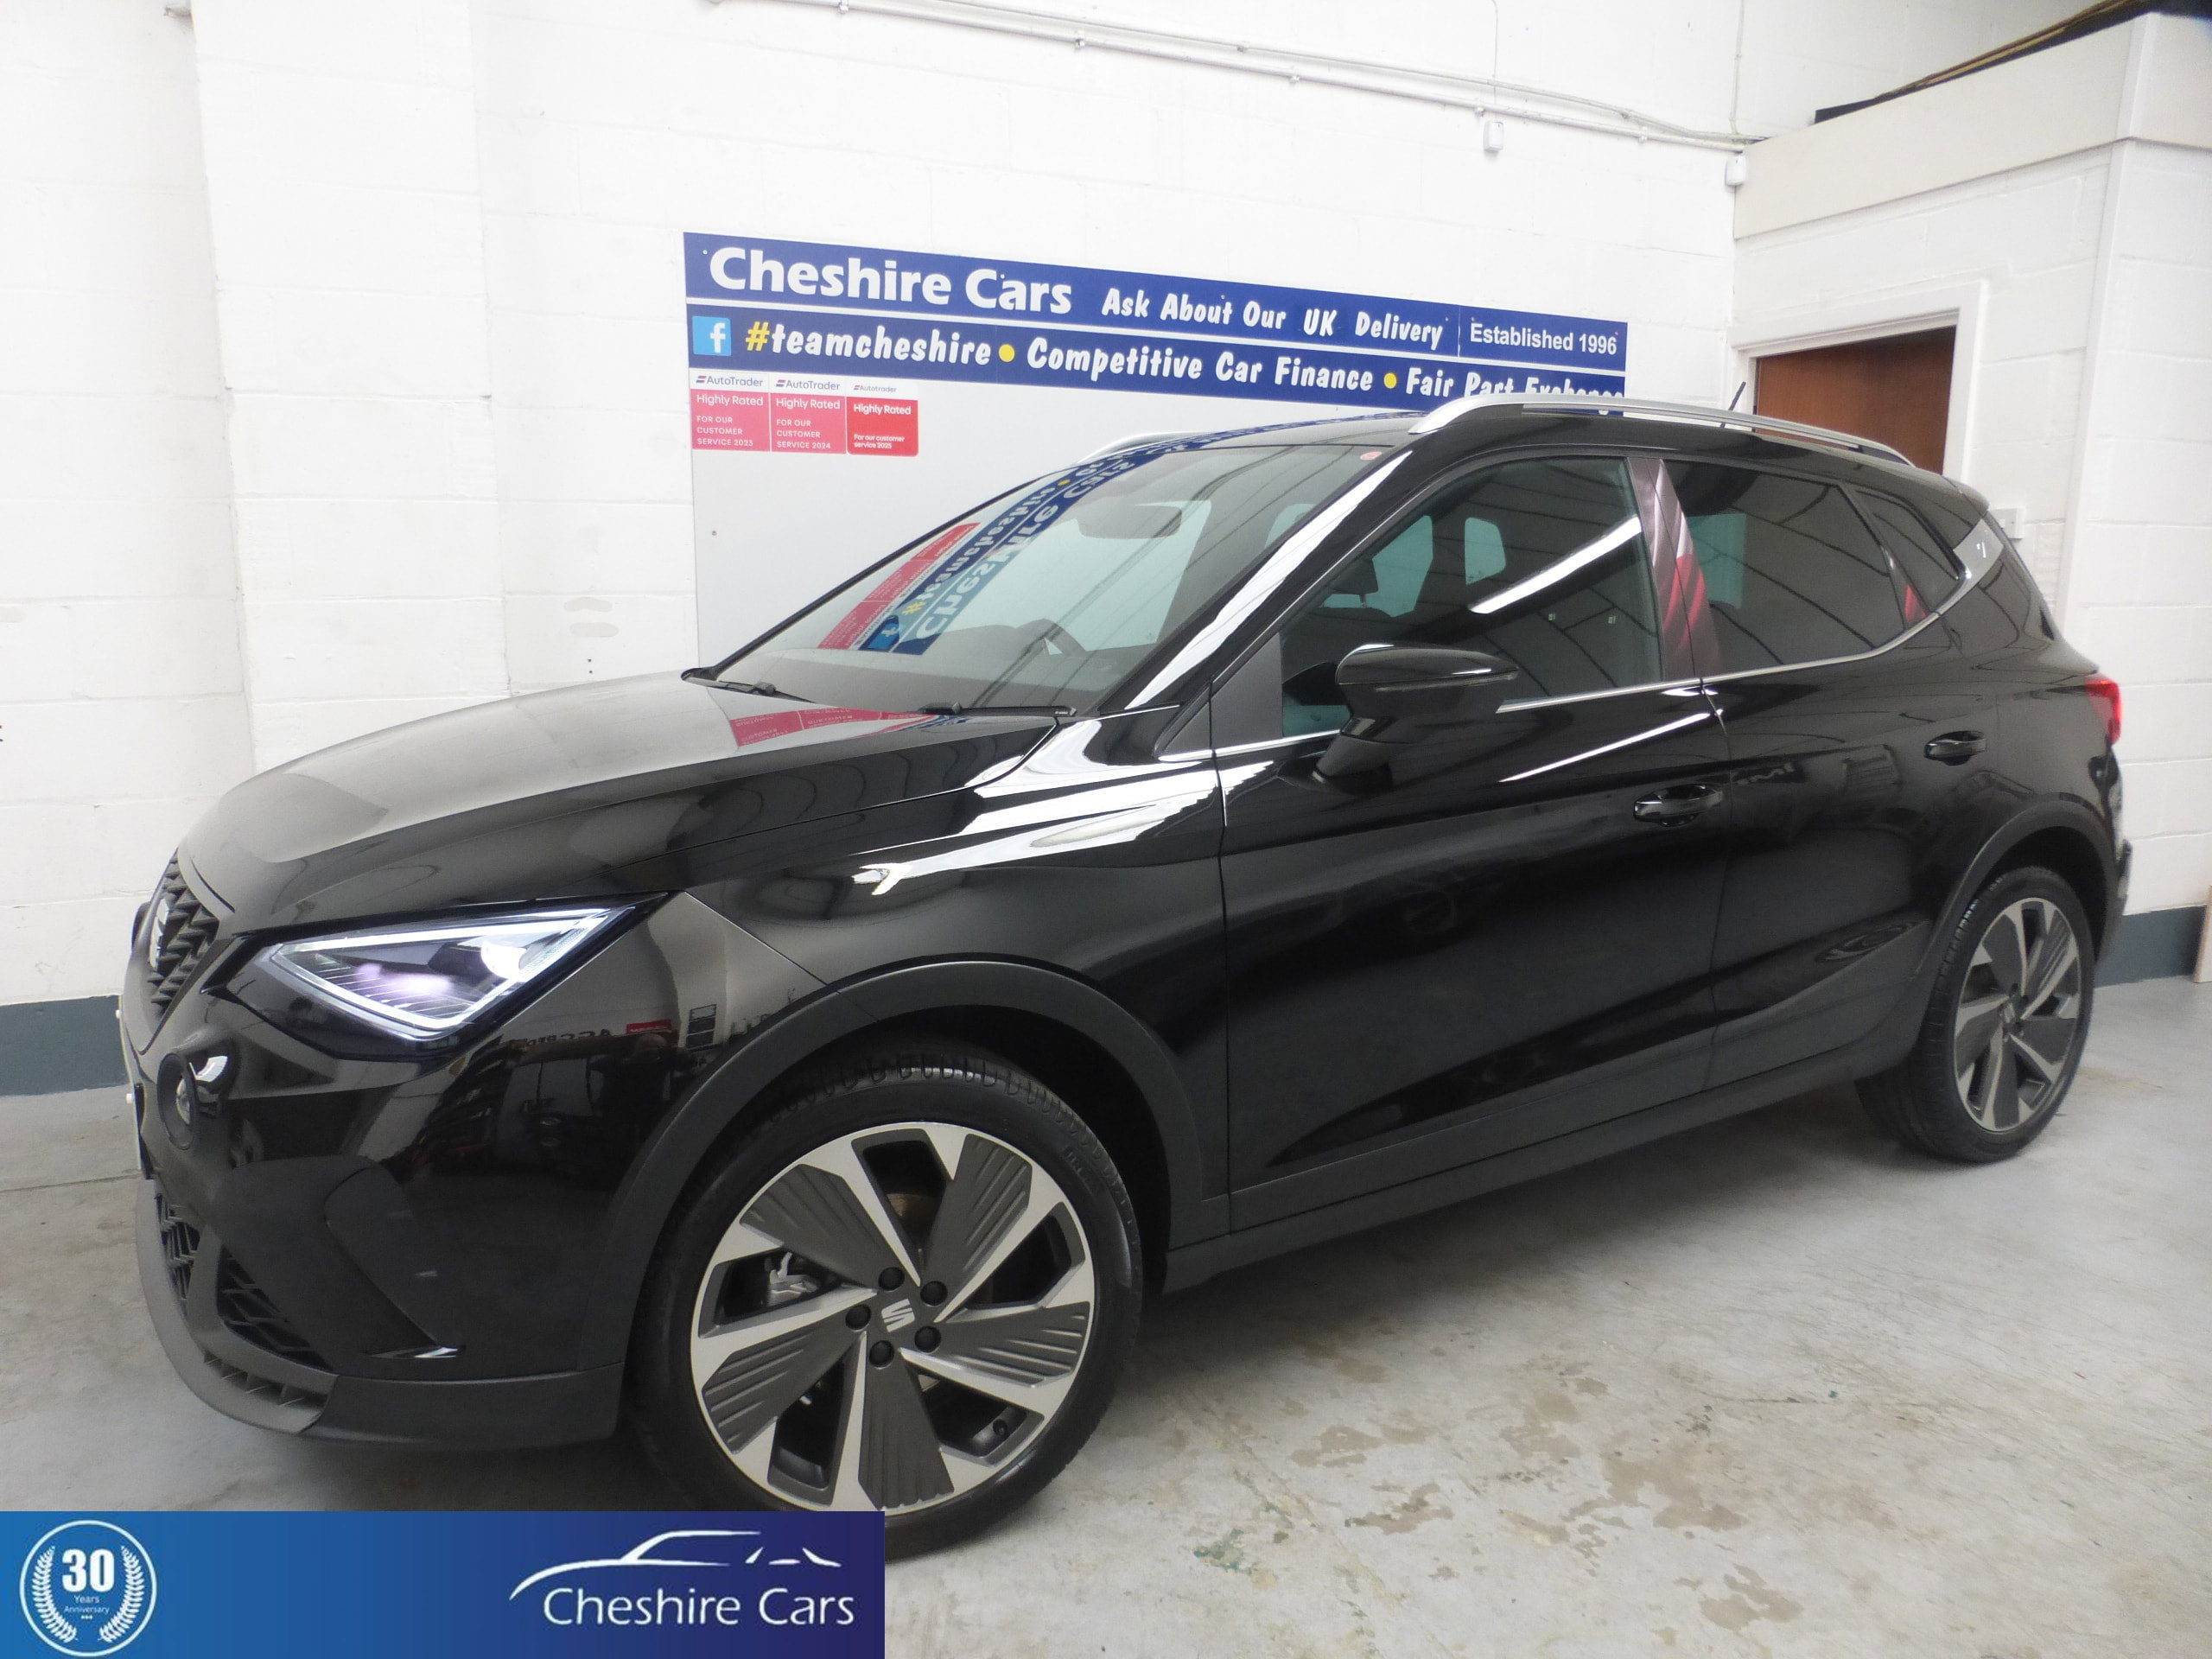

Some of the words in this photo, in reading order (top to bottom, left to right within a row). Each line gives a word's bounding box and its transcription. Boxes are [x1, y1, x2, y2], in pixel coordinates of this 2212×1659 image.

[709, 247, 951, 305] Cheshire
[966, 269, 1071, 314] Cars
[1101, 288, 1149, 319] Ask
[1160, 293, 1232, 324] About
[1243, 301, 1287, 330] Our
[1303, 308, 1338, 336] UK
[1355, 312, 1443, 349] Delivery
[746, 321, 990, 365] #teamcheshire
[1470, 322, 1573, 352] Established
[1580, 334, 1618, 356] 1996
[1027, 337, 1202, 382] Competitive
[1215, 352, 1263, 384] Car
[1274, 357, 1374, 391] Finance
[706, 375, 763, 387] AutoTrader
[785, 379, 840, 391] AutoTrader
[1406, 367, 1454, 397] Fair
[1464, 372, 1514, 398] Part
[696, 393, 730, 406] Highly
[732, 395, 764, 406] Rated
[776, 397, 809, 410] Highly
[810, 399, 841, 410] Rated
[854, 403, 882, 415] Highly
[884, 405, 912, 415] Rated
[697, 437, 732, 446] SERVICE
[812, 442, 831, 450] 2024
